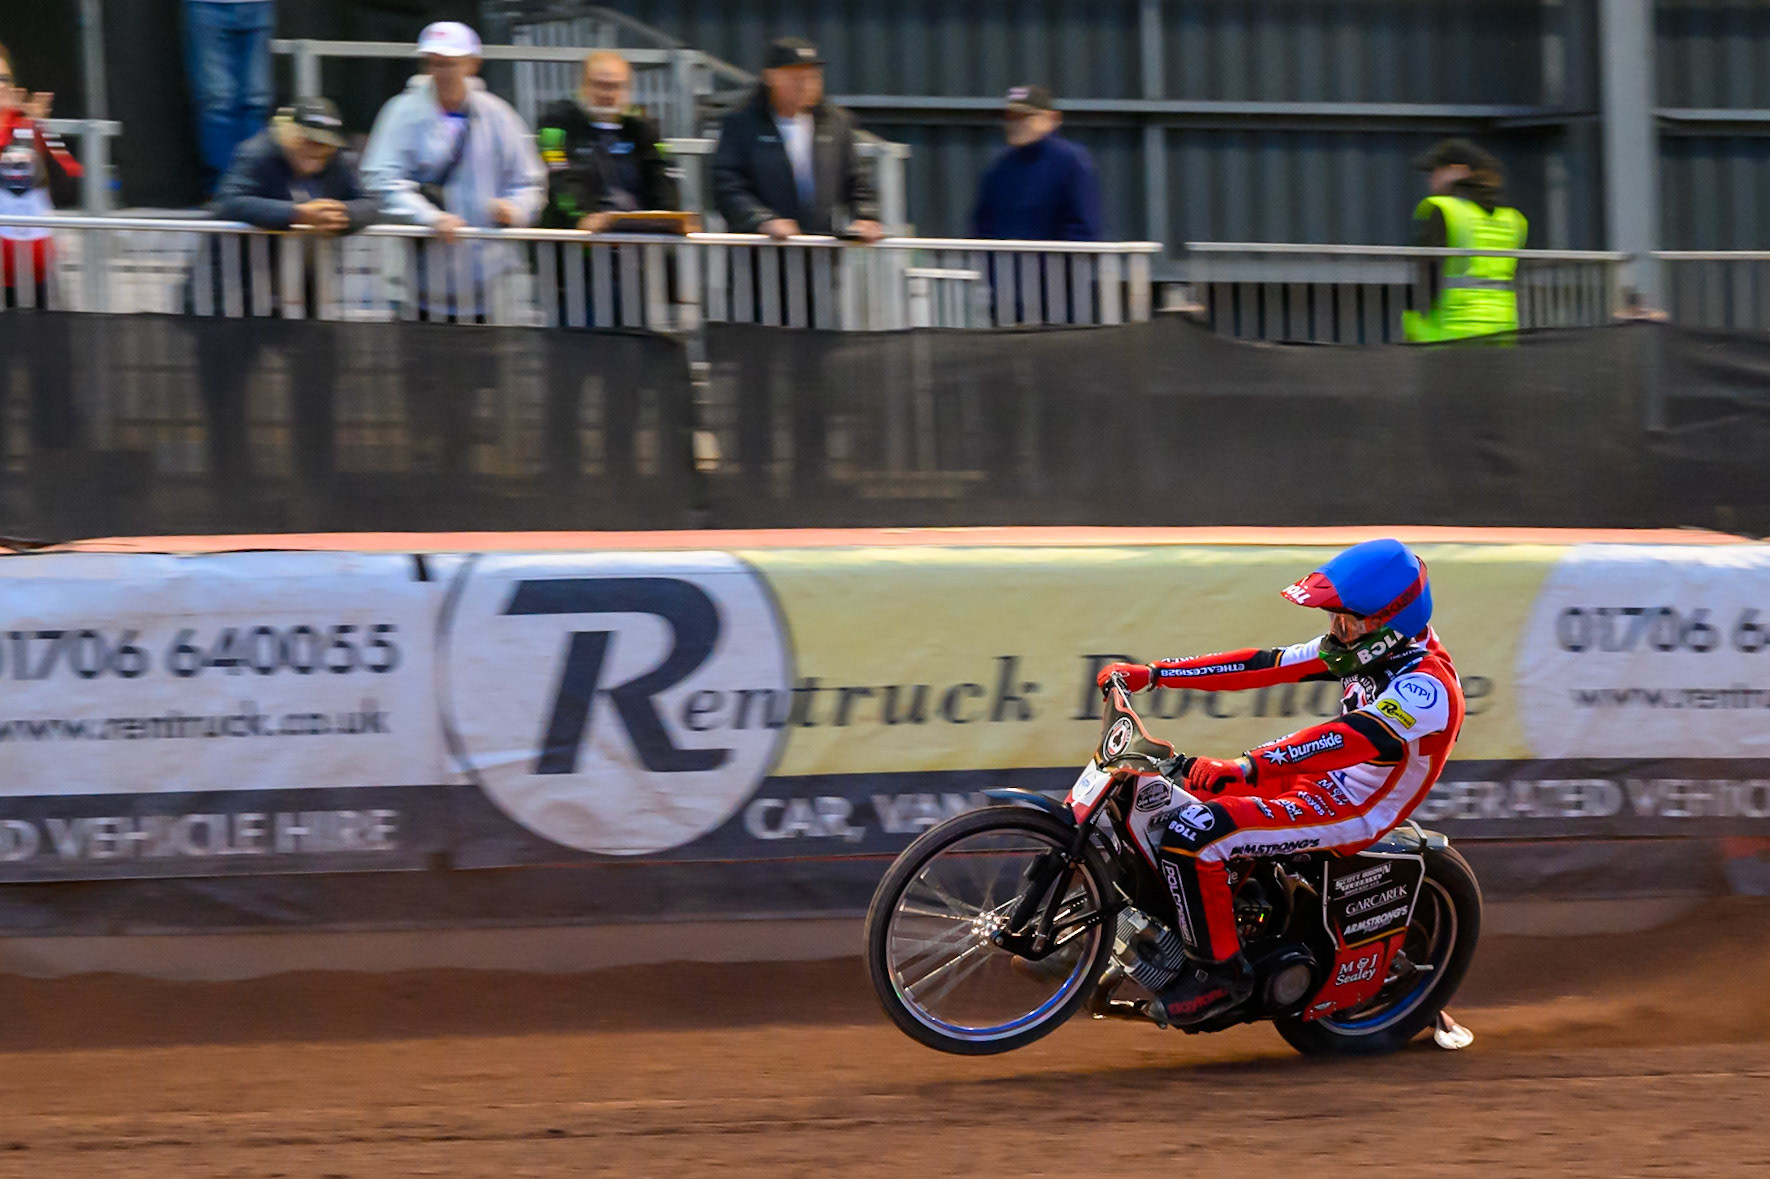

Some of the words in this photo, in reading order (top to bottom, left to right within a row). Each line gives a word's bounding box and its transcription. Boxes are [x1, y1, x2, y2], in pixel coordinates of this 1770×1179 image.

[1555, 606, 1721, 653] 01706
[1732, 607, 1770, 653] 6
[0, 628, 150, 680] 1706
[165, 623, 403, 678] 640055
[498, 576, 1043, 775] Rentruck
[1402, 682, 1431, 701] ATPI
[1287, 731, 1343, 758] burnside
[46, 812, 269, 860] VEHICLE
[274, 809, 399, 854] HIRE
[1168, 820, 1198, 841] BOLL
[1343, 905, 1409, 936] ARMSTRONG'S
[1335, 966, 1377, 986] Sealey
[1338, 962, 1354, 977] M
[1356, 957, 1370, 971] &
[1368, 953, 1378, 970] J
